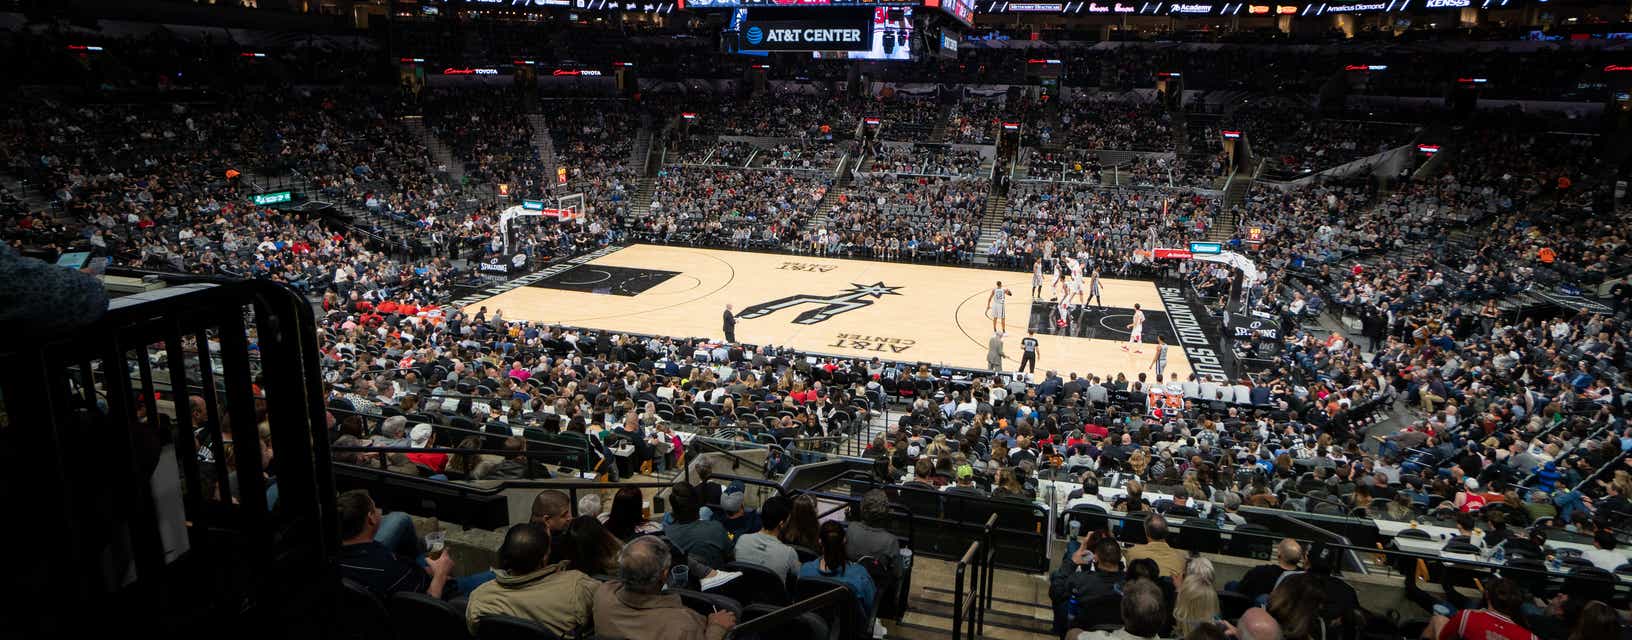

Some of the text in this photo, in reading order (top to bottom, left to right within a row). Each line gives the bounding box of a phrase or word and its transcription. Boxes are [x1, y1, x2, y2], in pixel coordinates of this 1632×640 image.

[766, 29, 861, 42] AT&T CENTER
[1159, 287, 1187, 304] SAN
[1165, 301, 1209, 345] ANTONIO
[828, 340, 912, 353] AT&T
[837, 333, 916, 345] CENTER
[1186, 347, 1229, 382] SPUR
